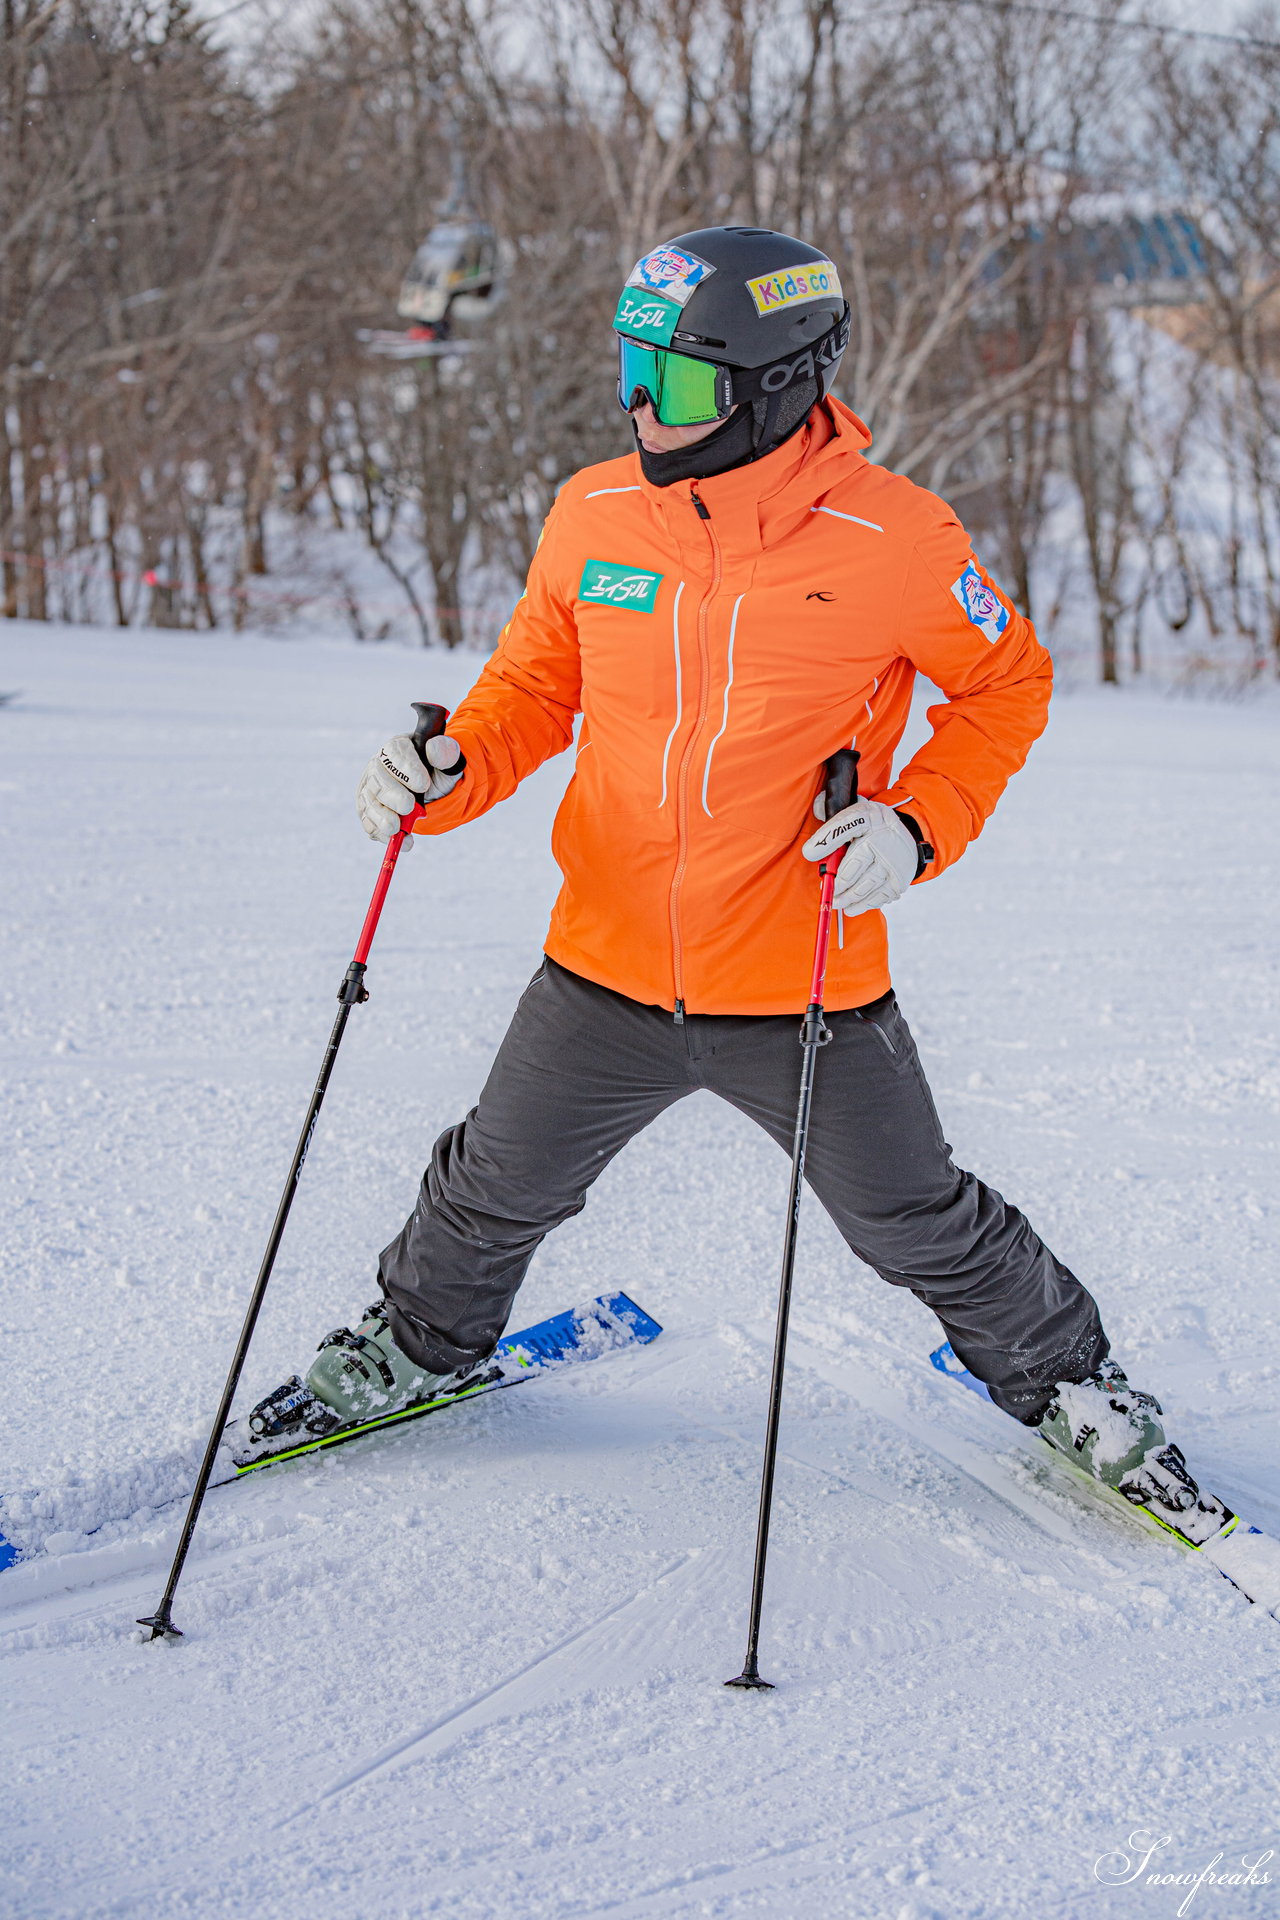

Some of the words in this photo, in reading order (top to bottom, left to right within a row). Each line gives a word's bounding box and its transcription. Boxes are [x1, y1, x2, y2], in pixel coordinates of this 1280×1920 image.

[758, 273, 809, 306] Kids
[617, 301, 672, 329] エイブル
[760, 318, 850, 393] OAKLE
[584, 575, 657, 602] エイブル
